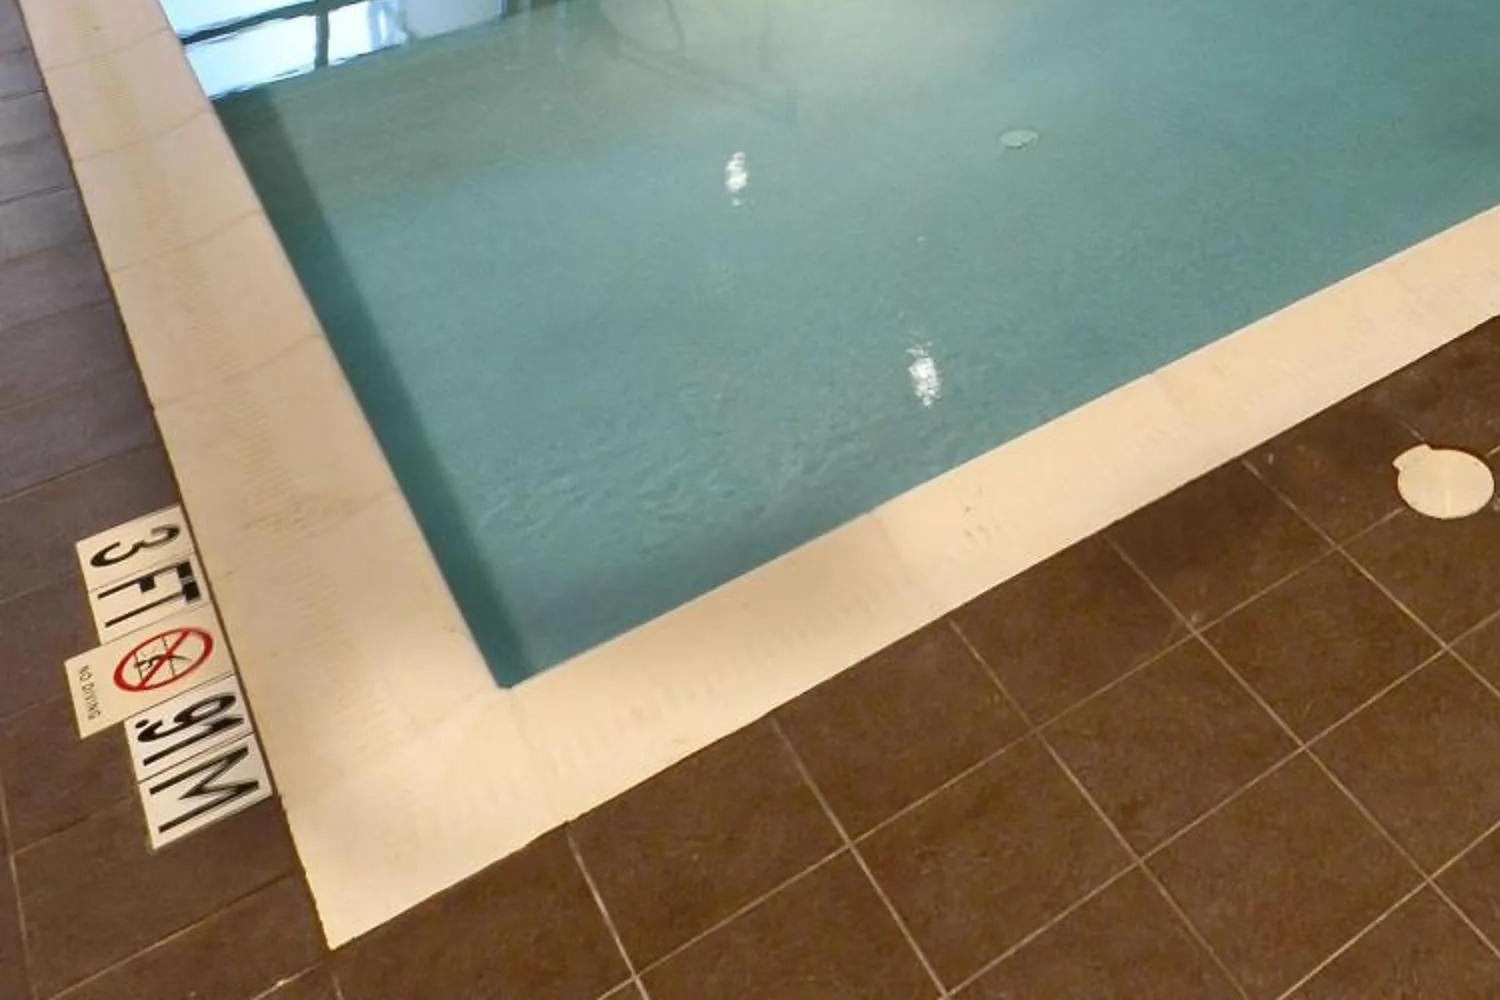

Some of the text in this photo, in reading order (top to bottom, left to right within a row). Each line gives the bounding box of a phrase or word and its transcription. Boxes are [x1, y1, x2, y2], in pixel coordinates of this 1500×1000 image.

[79, 665, 102, 721] NO DIVING
[90, 523, 261, 833] 3 FT .91 M
